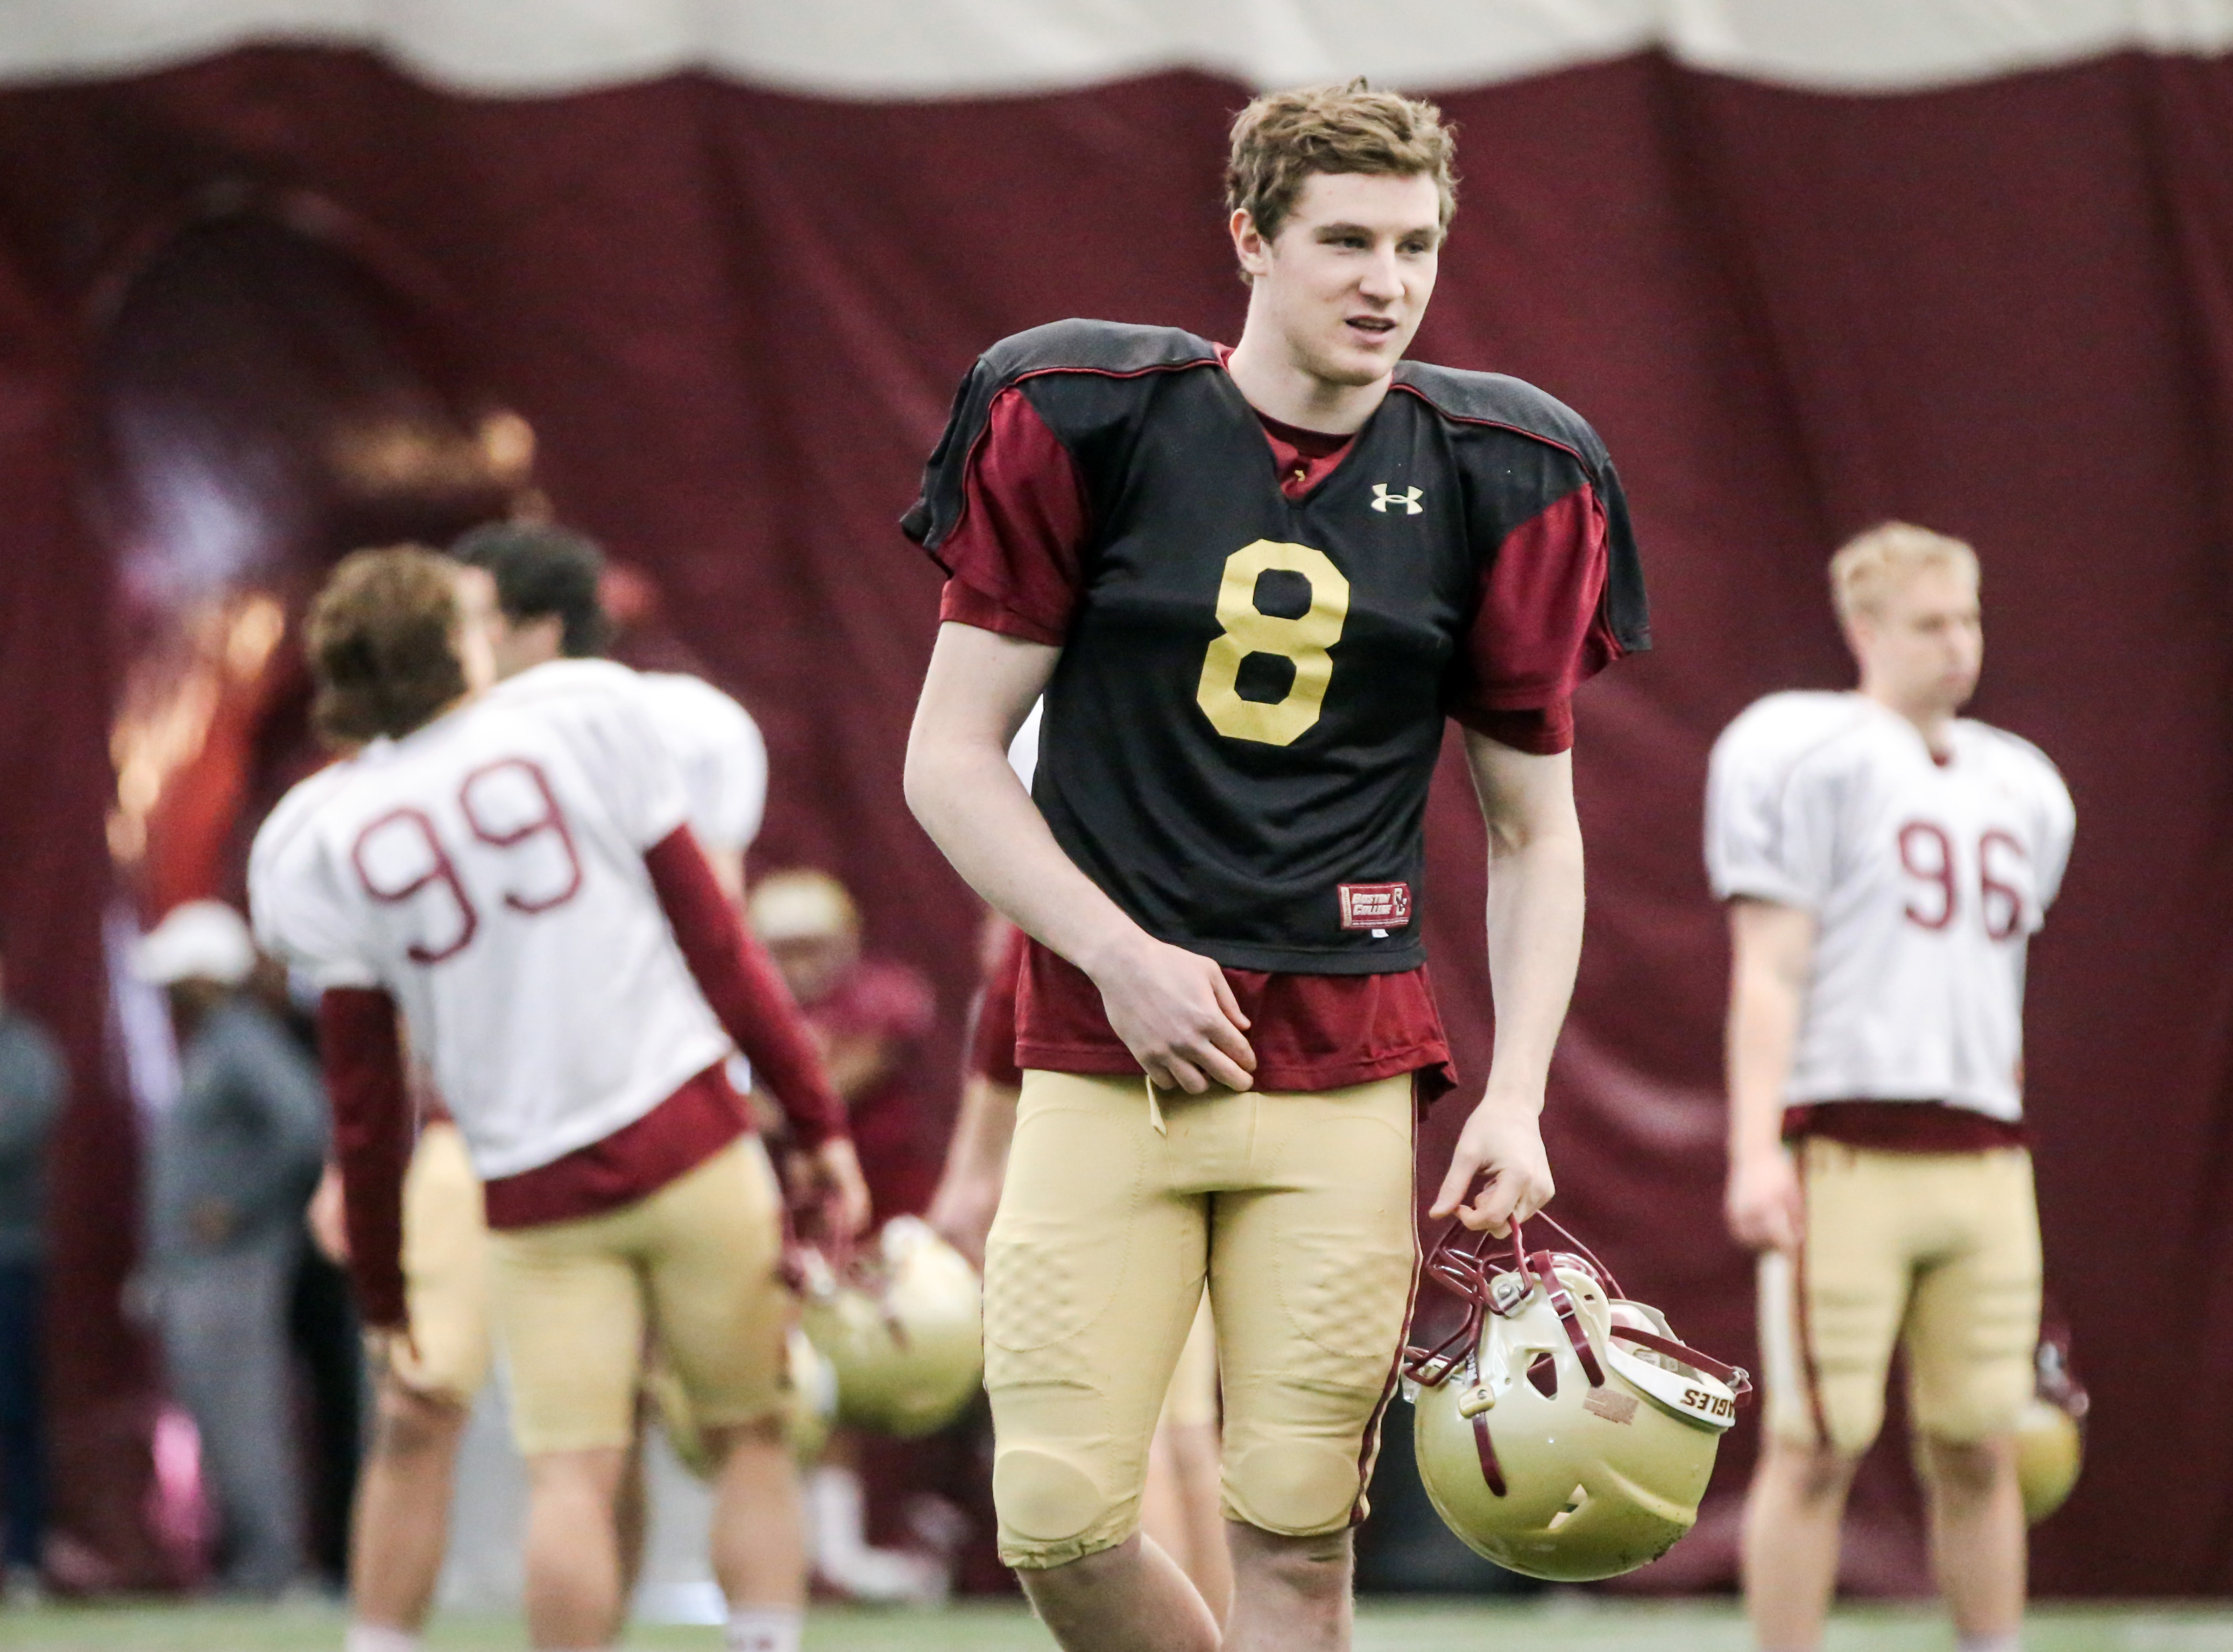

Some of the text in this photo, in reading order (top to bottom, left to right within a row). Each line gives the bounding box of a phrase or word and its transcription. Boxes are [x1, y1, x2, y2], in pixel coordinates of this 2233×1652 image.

[1197, 539, 1349, 746] 8
[351, 758, 583, 964] 99
[1898, 821, 2026, 941] 96
